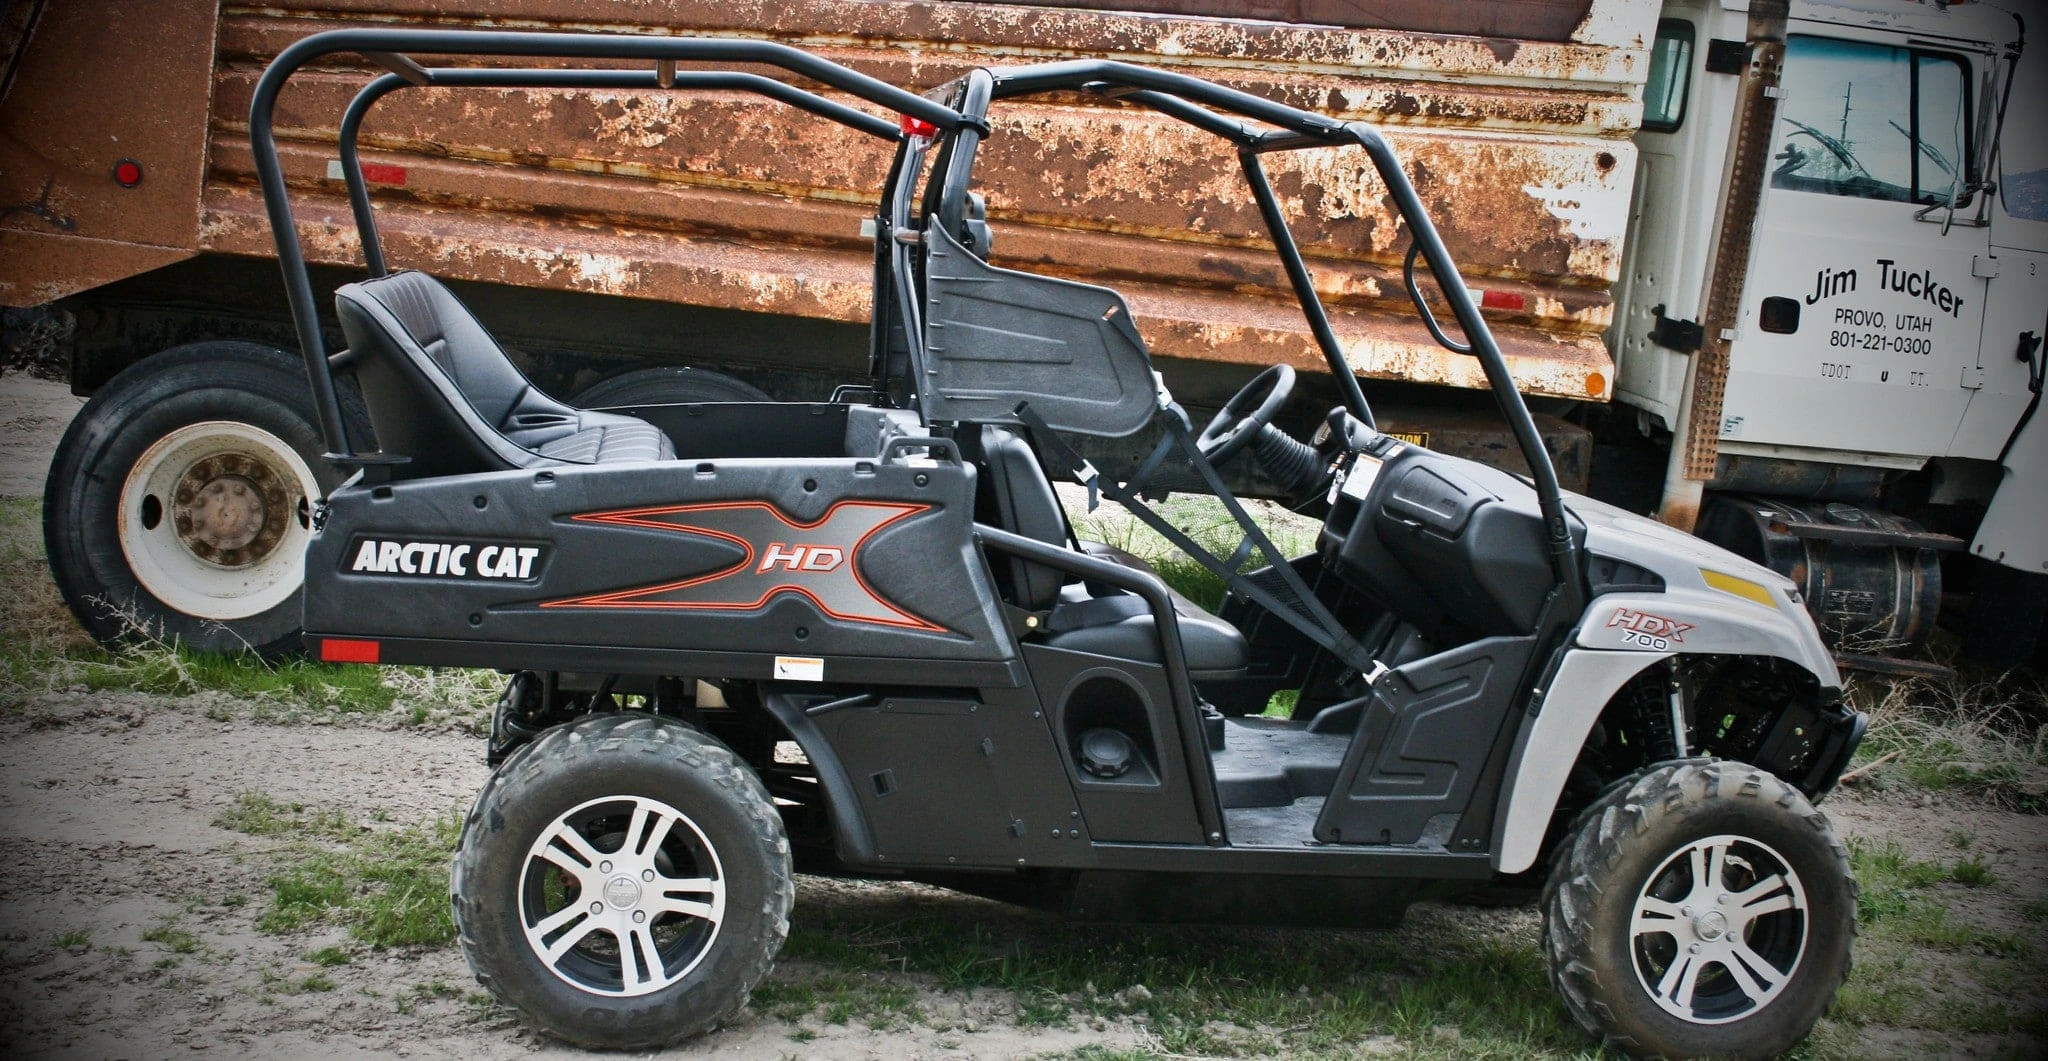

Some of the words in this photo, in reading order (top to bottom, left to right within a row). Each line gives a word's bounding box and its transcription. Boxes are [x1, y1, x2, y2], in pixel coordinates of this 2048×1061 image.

[1806, 268, 1857, 305] Jim
[1876, 259, 1964, 318] Tucker
[1834, 308, 1887, 331] PROVO,
[1895, 314, 1932, 333] UTAH
[1830, 330, 1932, 355] 801-221-0300
[352, 540, 471, 576] ARCTIC
[476, 546, 539, 578] CAT
[757, 543, 845, 574] HD
[1606, 608, 1695, 642] HDX
[1622, 630, 1668, 650] 700
